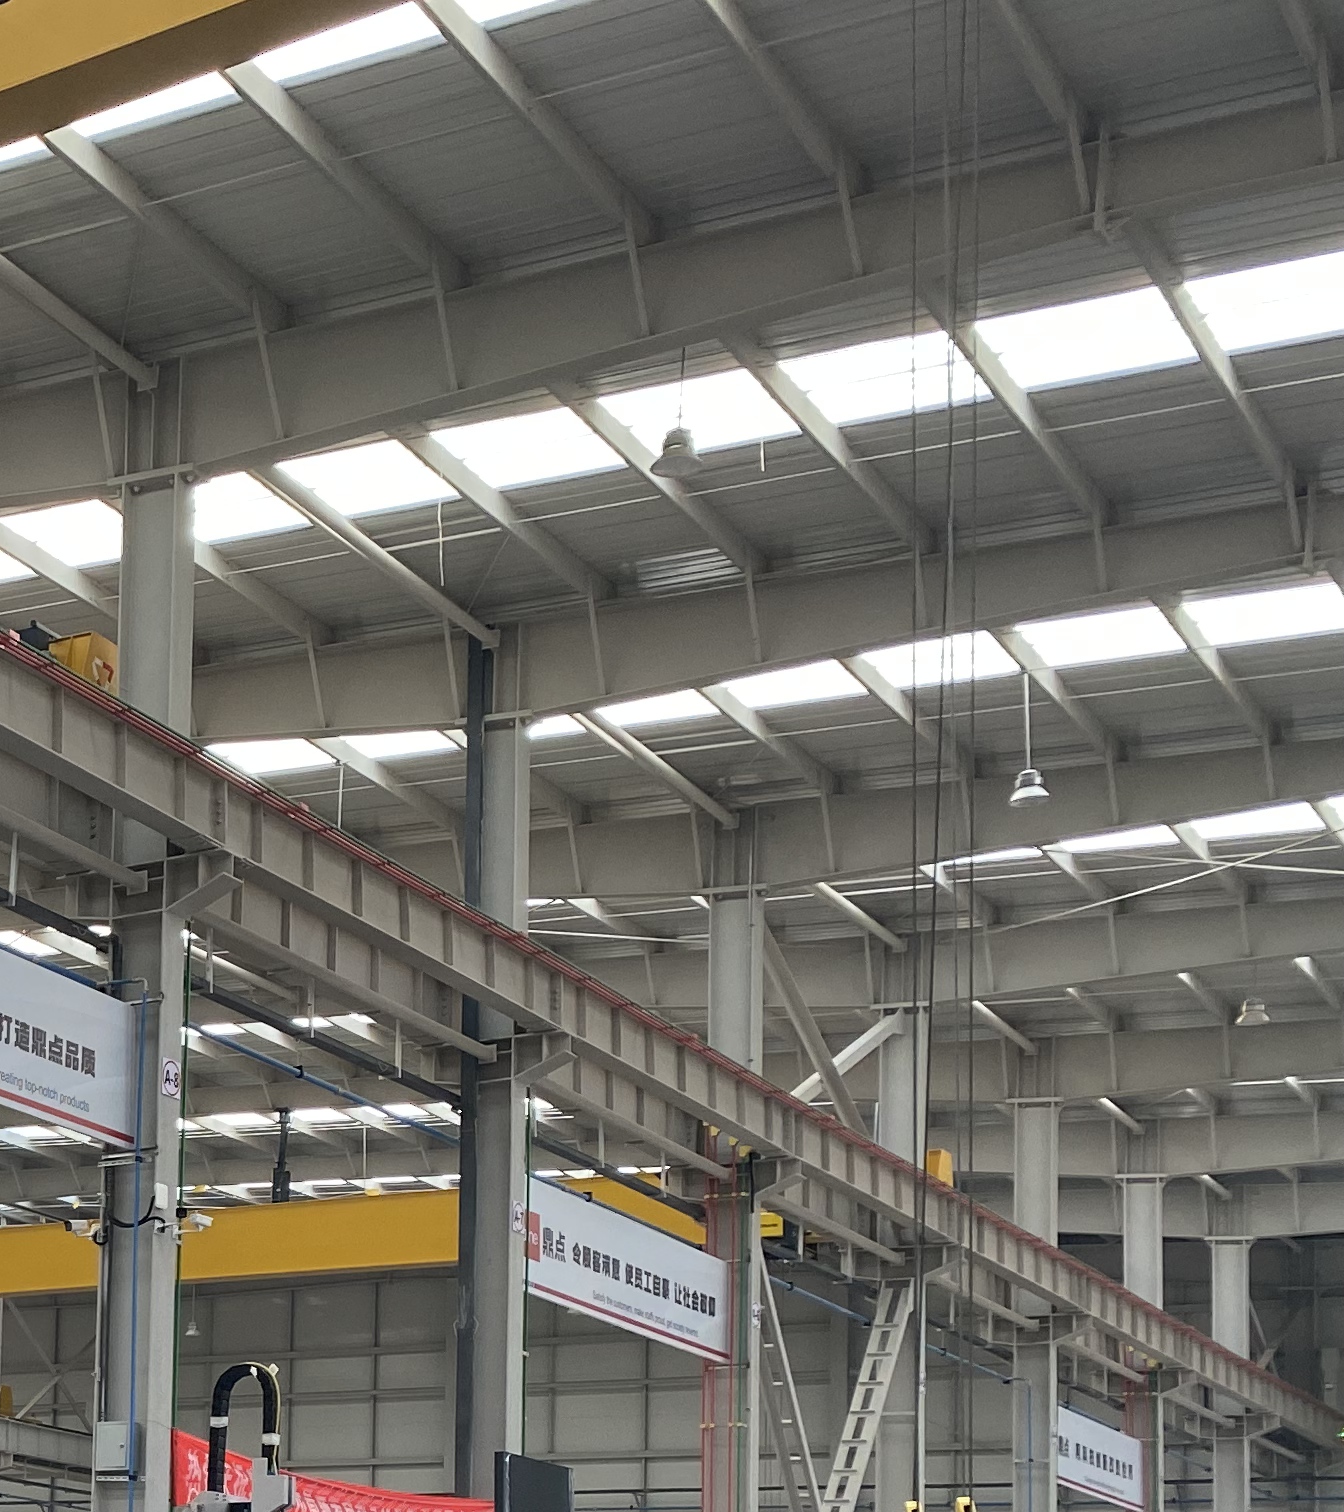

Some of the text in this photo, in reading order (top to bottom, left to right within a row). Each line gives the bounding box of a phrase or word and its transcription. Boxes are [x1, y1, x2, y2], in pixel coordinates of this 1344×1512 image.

[25, 1077, 58, 1101] top-notch
[59, 1085, 90, 1113] products
[543, 1226, 567, 1263] 鼎点
